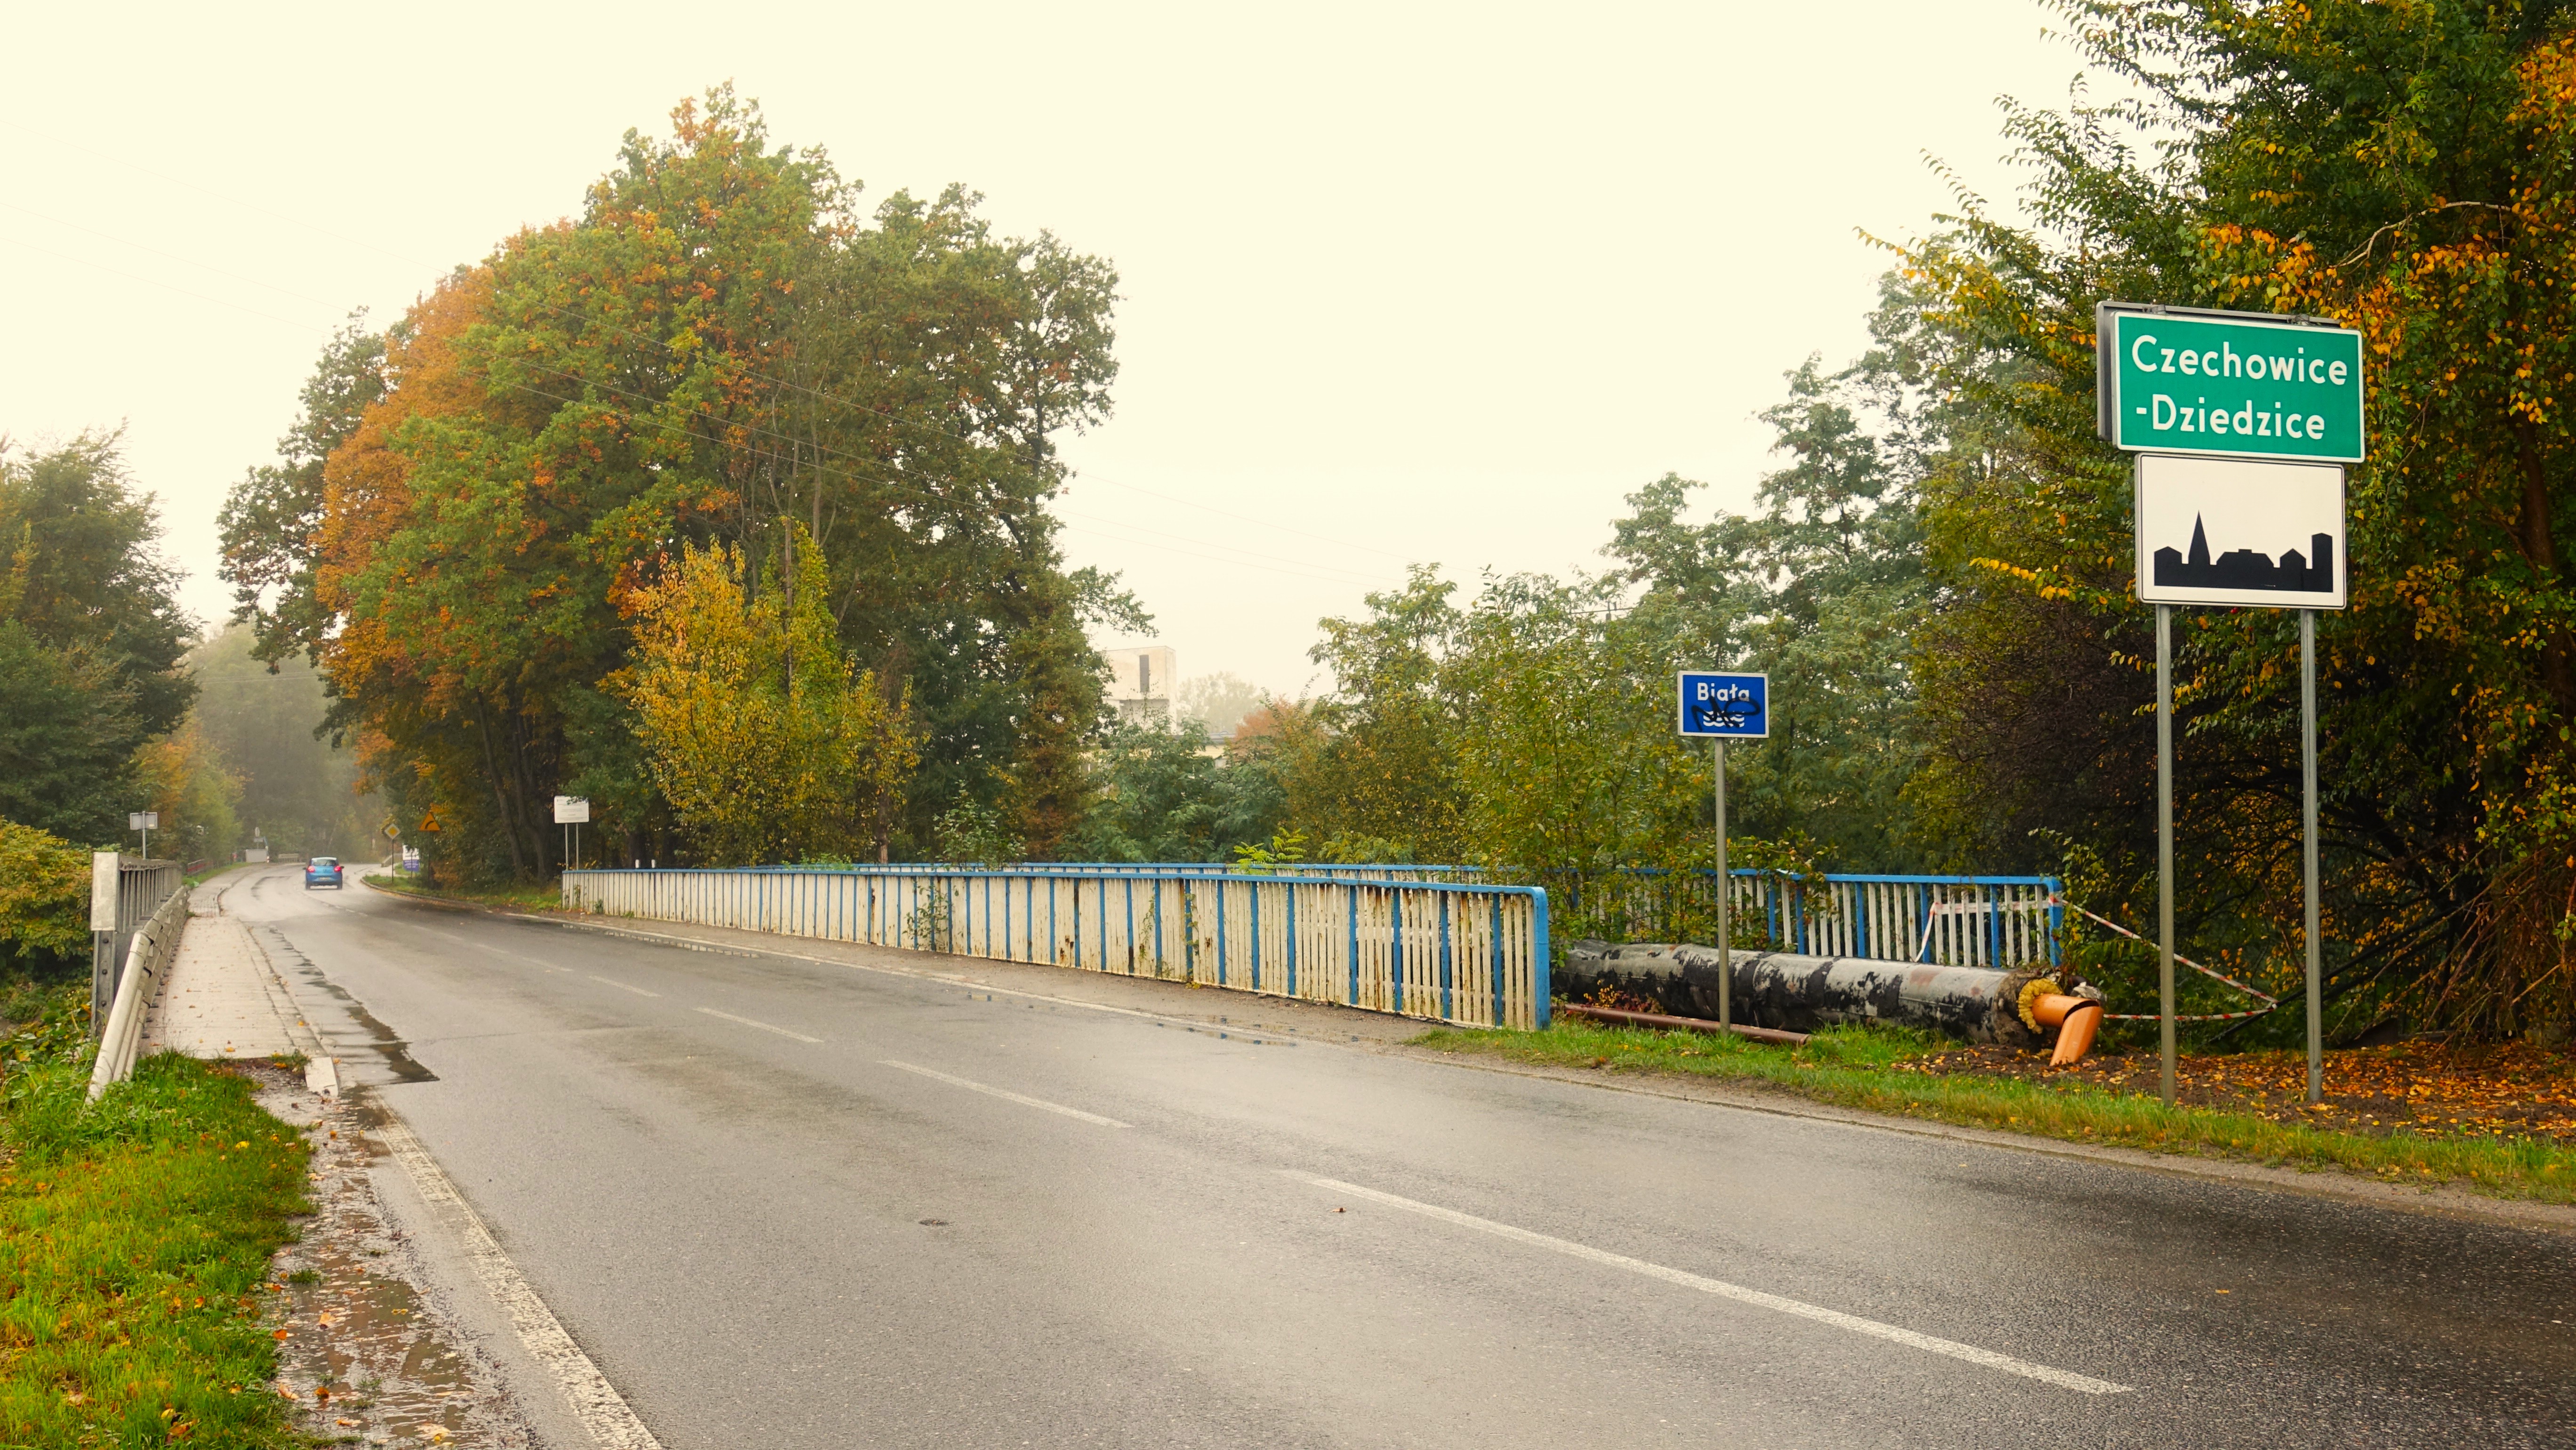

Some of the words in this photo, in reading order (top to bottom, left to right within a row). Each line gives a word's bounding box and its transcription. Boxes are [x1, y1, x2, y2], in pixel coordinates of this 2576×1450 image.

[2132, 334, 2347, 385] Czechowice
[2136, 394, 2325, 440] -Dziedzice
[1697, 682, 1749, 701] Biała
